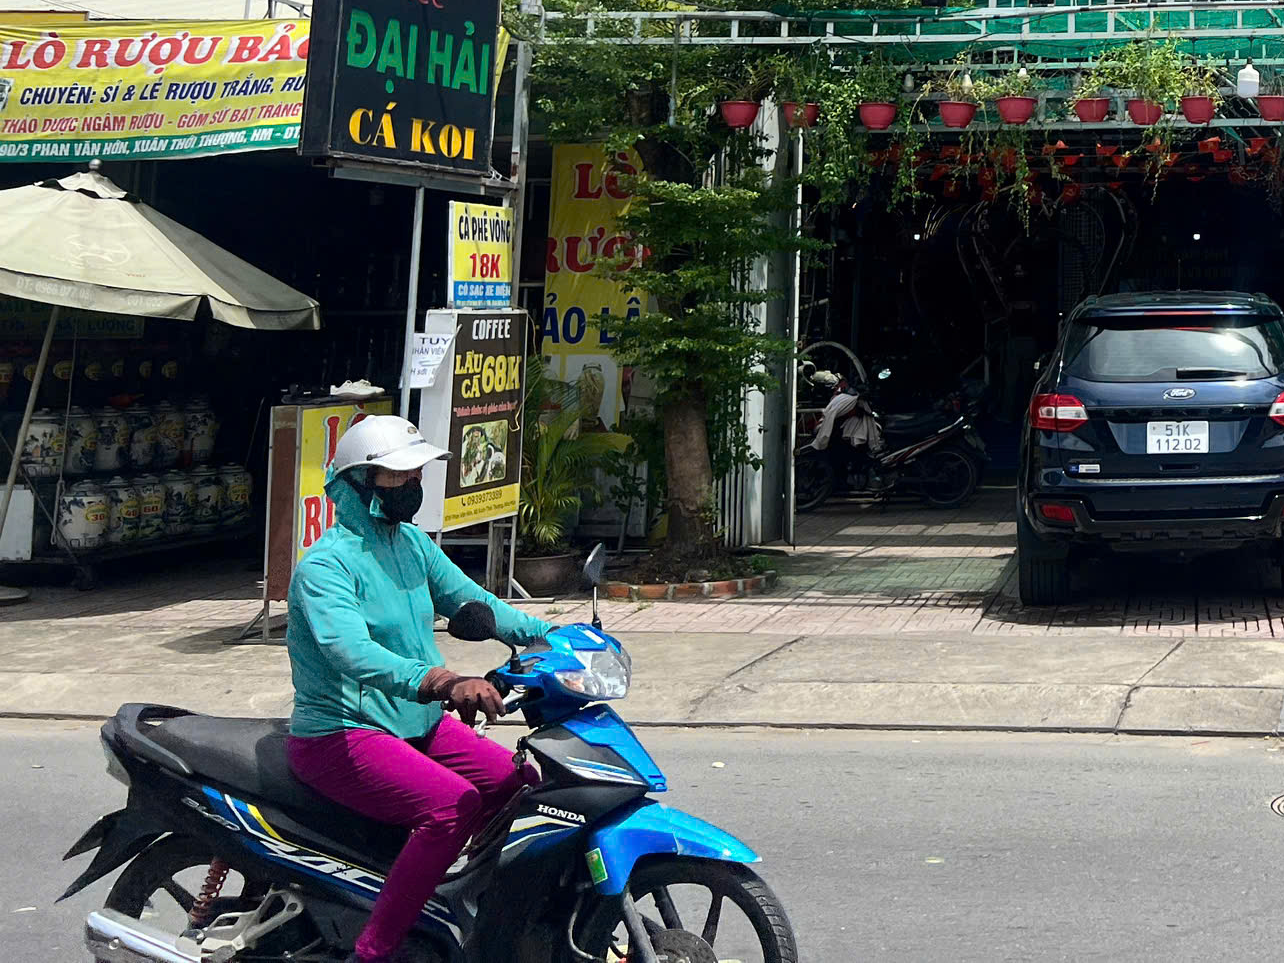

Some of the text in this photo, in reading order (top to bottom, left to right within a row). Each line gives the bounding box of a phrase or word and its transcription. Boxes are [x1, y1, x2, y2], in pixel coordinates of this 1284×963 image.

[2, 32, 66, 69] LÒ
[76, 32, 223, 74] RƯỢU
[346, 8, 490, 95] ĐẠI HẢI
[20, 83, 97, 105] CHUYÊN:
[122, 85, 136, 102] &
[165, 81, 217, 104] RƯỢU
[81, 113, 126, 132] NGÂM
[349, 101, 476, 160] CÁ KOI
[32, 143, 70, 156] PHAN
[73, 141, 100, 156] VĂN
[133, 137, 168, 154] XUÂN
[251, 128, 274, 141] HM
[459, 207, 469, 240] CÀ
[472, 210, 488, 241] PHÊ
[470, 253, 501, 278] 18K
[472, 319, 512, 340] COFFEE
[543, 293, 586, 344] ẢO
[461, 374, 481, 398] CÁ
[482, 355, 522, 393] 68K
[1165, 424, 1190, 437] 51K
[1156, 438, 1201, 451] 112.02
[537, 804, 586, 823] HONDA
